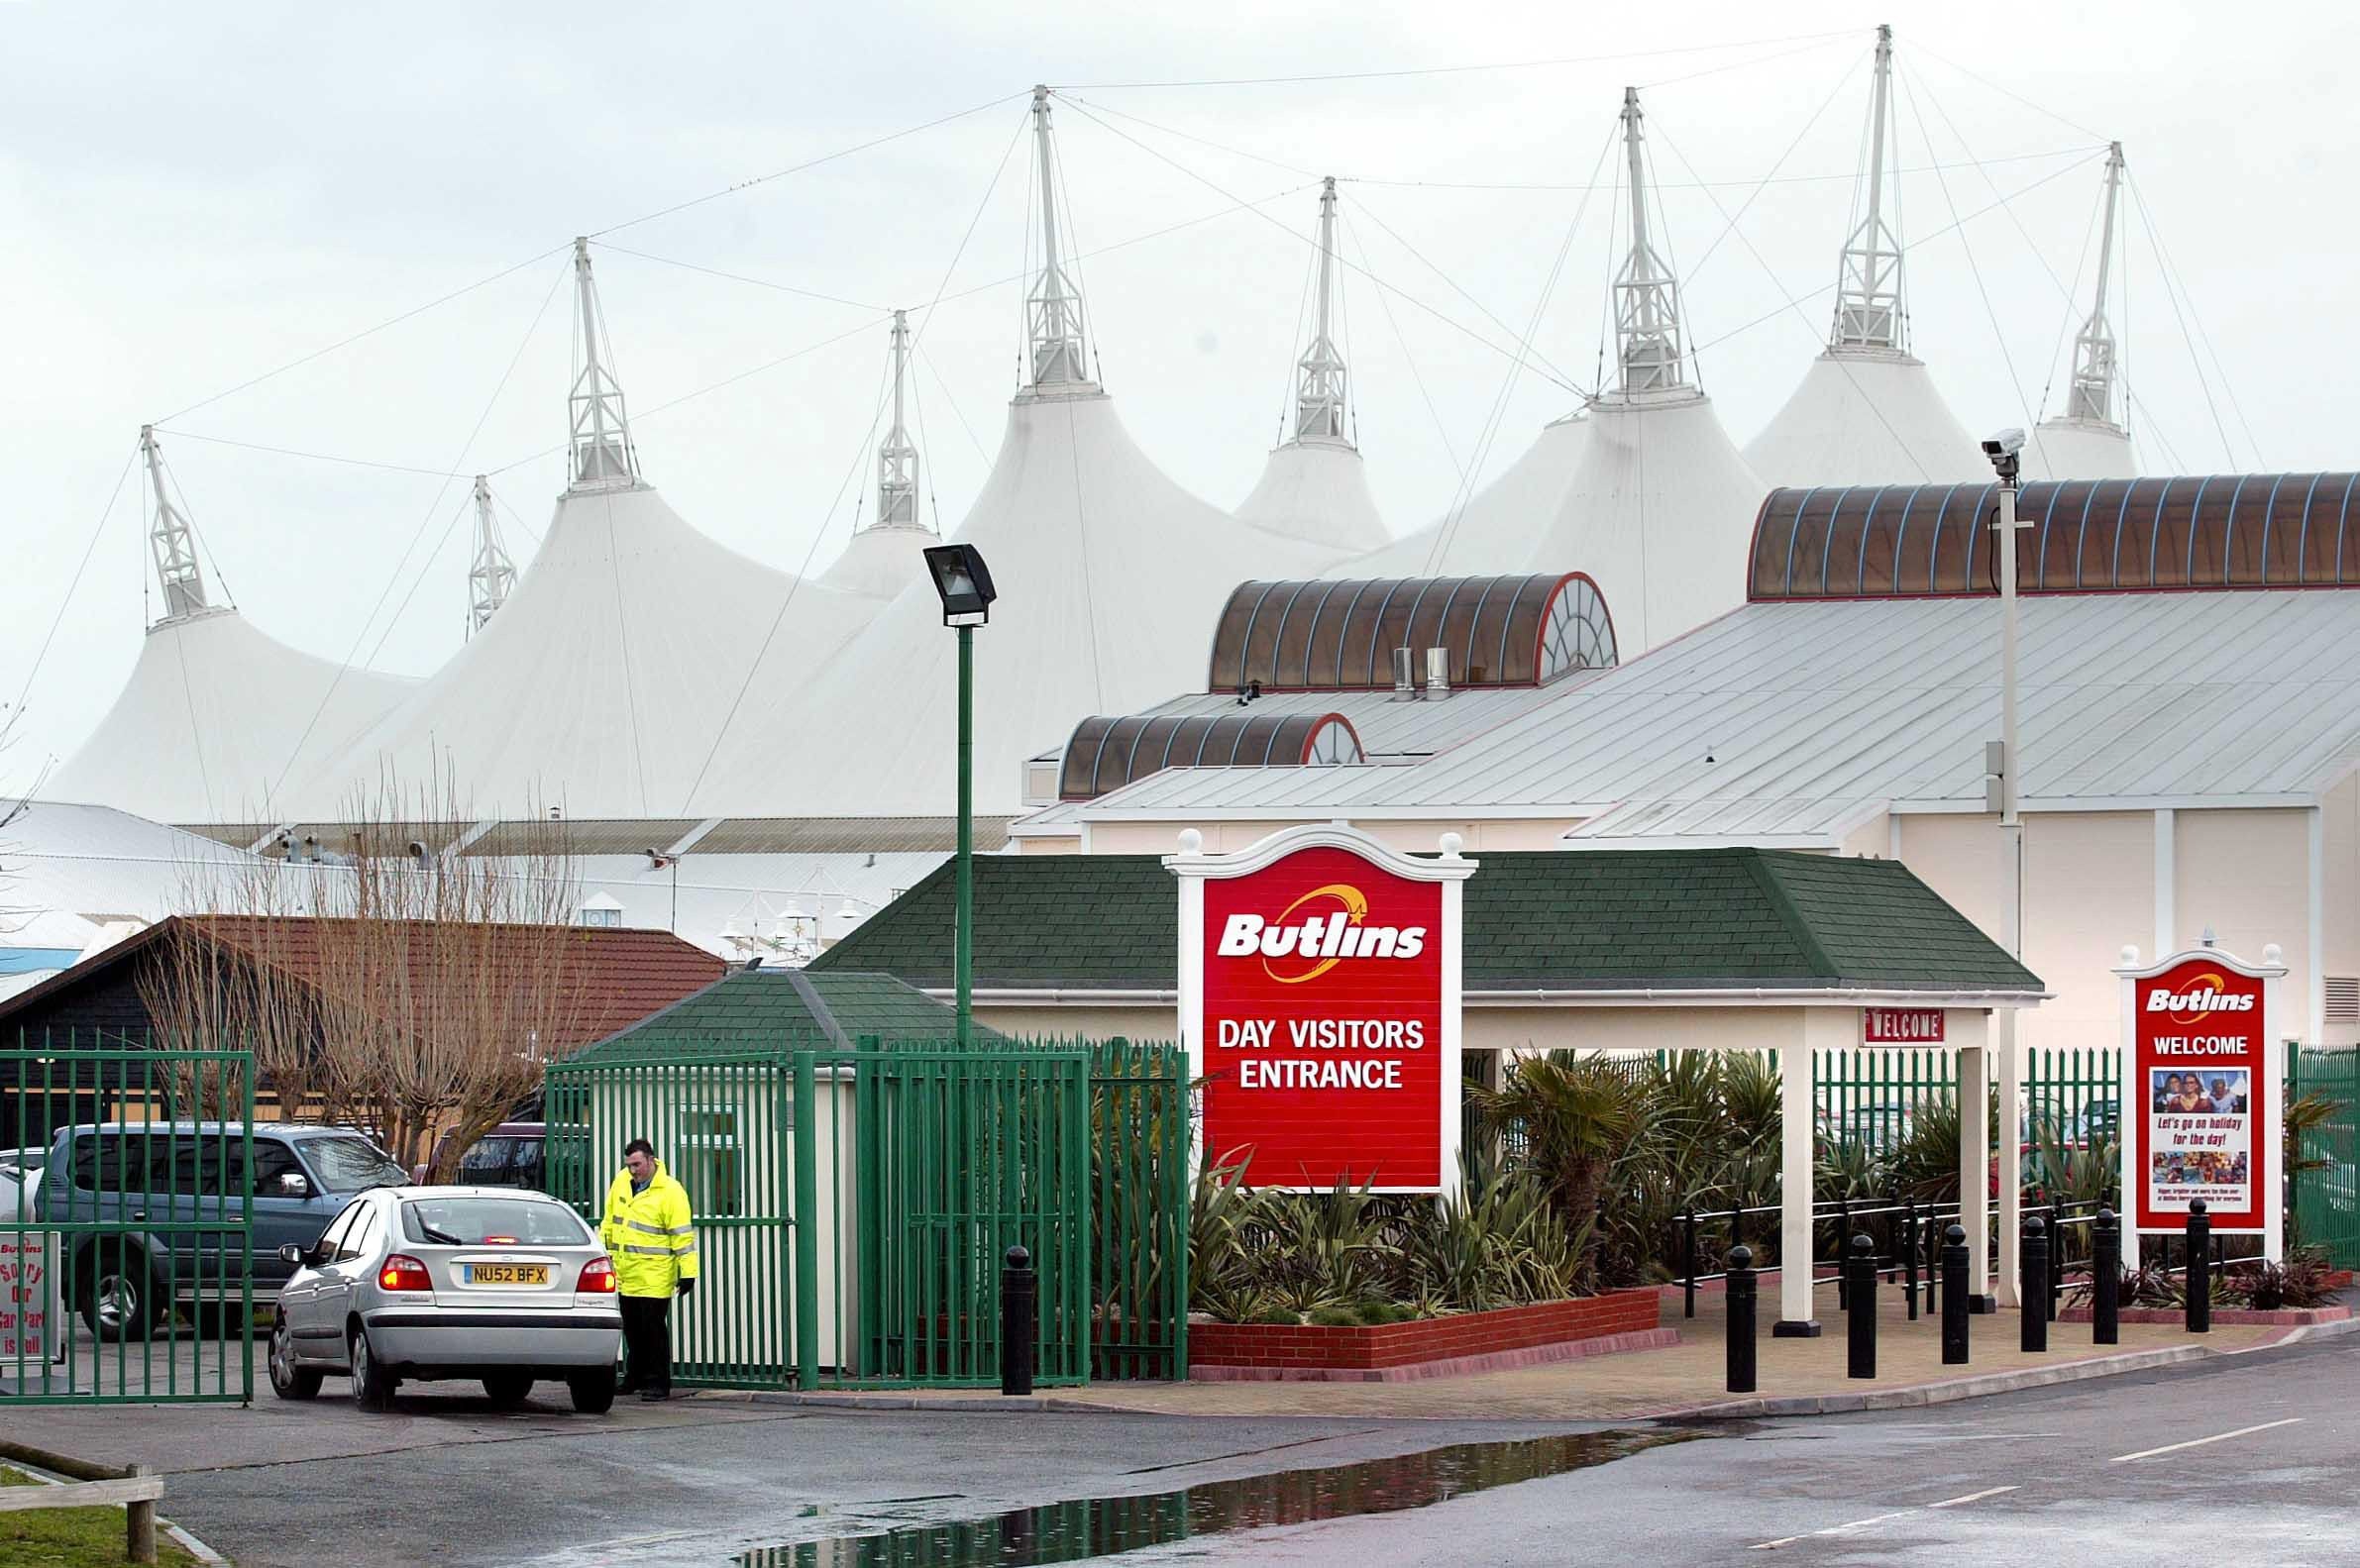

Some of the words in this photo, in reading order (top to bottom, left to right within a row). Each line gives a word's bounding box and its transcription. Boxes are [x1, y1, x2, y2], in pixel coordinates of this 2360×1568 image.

[1217, 911, 1428, 959] Butlins
[2146, 987, 2255, 1012] Butlins
[1218, 1019, 1276, 1049] DAY
[1289, 1019, 1425, 1049] VISITORS
[1873, 1013, 1939, 1038] WELCOME
[2153, 1036, 2249, 1055] WELCOME
[1239, 1059, 1403, 1089] ENTRANCE
[2158, 1116, 2180, 1129] Let's
[2182, 1118, 2193, 1131] go
[2196, 1118, 2207, 1129] on
[2209, 1116, 2242, 1131] holiday
[2173, 1133, 2188, 1145] for
[2190, 1133, 2204, 1145] the
[2206, 1133, 2226, 1147] day!
[0, 1262, 44, 1285] Sory
[474, 1267, 512, 1282] NU52
[517, 1267, 545, 1282] BFX
[23, 1335, 41, 1355] ull
